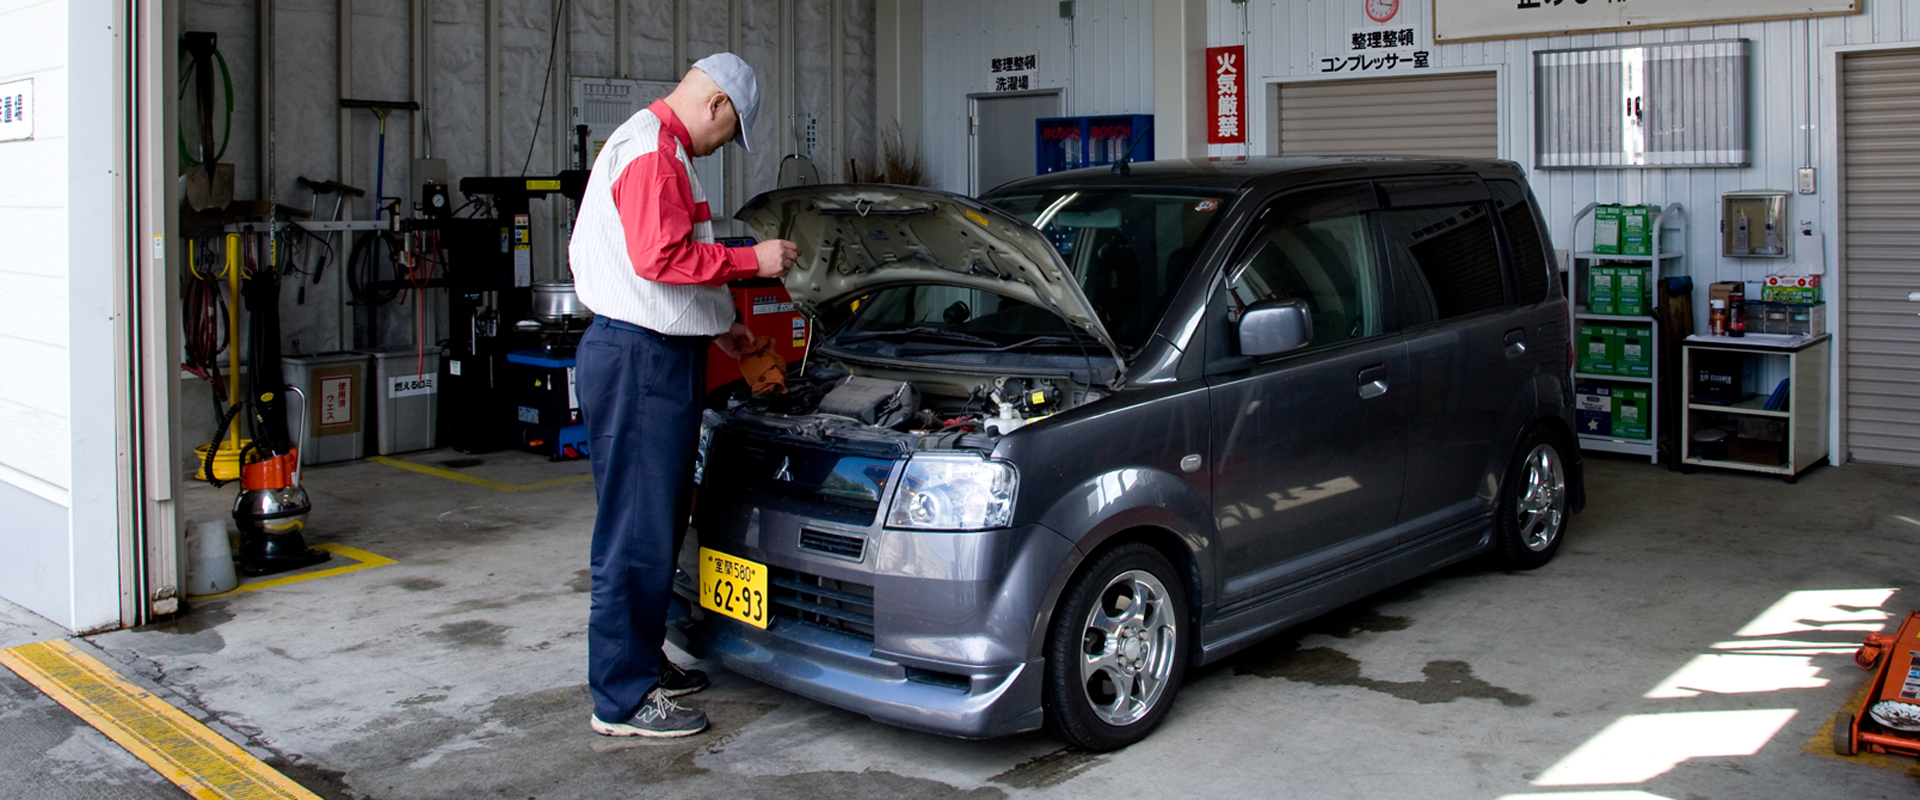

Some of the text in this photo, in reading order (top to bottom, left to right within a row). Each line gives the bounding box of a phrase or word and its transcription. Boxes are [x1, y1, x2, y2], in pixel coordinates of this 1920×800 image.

[1351, 28, 1414, 50] 整理整頓
[991, 54, 1036, 73] 整理整頓
[1321, 51, 1429, 72] コンプレッサー室
[996, 75, 1029, 91] 洗濯場
[1217, 52, 1238, 137] 火気厳禁
[0, 94, 23, 123] 置場
[1091, 125, 1132, 139] BOSCH
[326, 394, 335, 420] ウエス
[338, 382, 347, 408] 使用済
[703, 578, 763, 622] い 62-93
